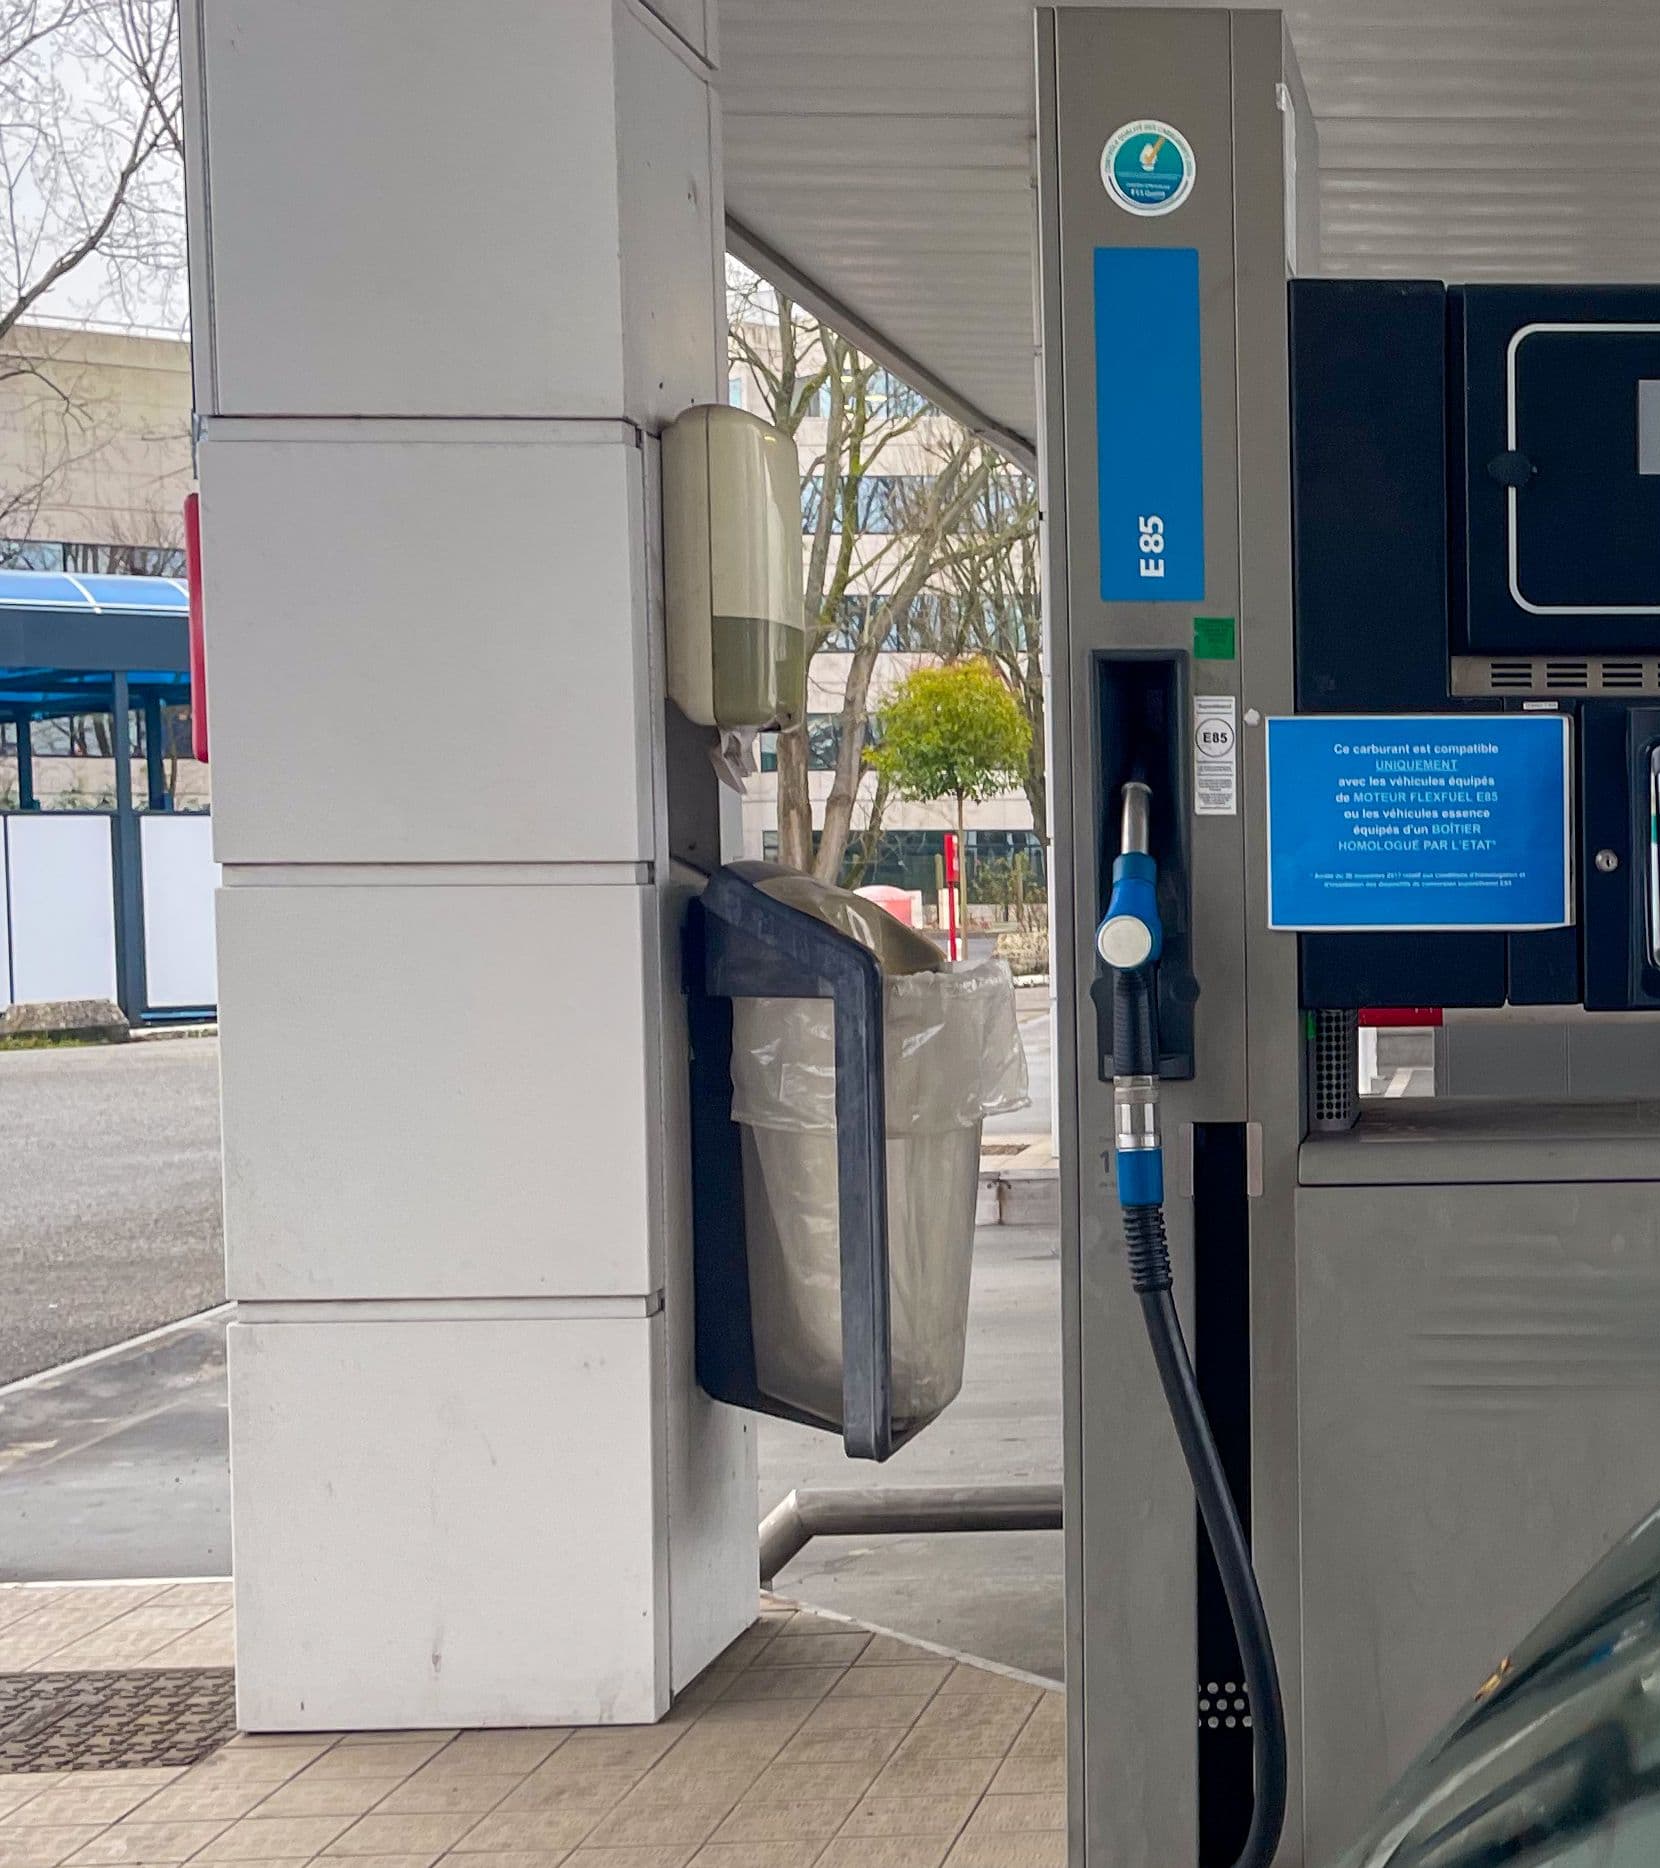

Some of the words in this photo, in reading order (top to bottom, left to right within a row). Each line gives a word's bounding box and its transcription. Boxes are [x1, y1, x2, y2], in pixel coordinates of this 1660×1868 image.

[1203, 732, 1228, 743] E85
[1334, 744, 1350, 754] Ce
[1353, 744, 1410, 754] carburant
[1413, 745, 1431, 754] est
[1434, 743, 1499, 756] compatible
[1375, 759, 1458, 771] UNIQUEMENT
[1338, 778, 1366, 787] avec
[1369, 776, 1386, 787] les
[1390, 776, 1445, 787] véhicules
[1448, 775, 1495, 788] équipés
[1335, 792, 1350, 803] de
[1353, 792, 1406, 802] MOTEUR
[1410, 791, 1473, 802] FLEXFUEL
[1476, 791, 1498, 802] E85
[1344, 809, 1359, 818] ou
[1362, 808, 1379, 818] les
[1383, 808, 1439, 818] véhicules
[1442, 809, 1490, 818] essence
[1353, 823, 1399, 837] équipés
[1403, 823, 1429, 834] d'un
[1423, 840, 1448, 850] PAR
